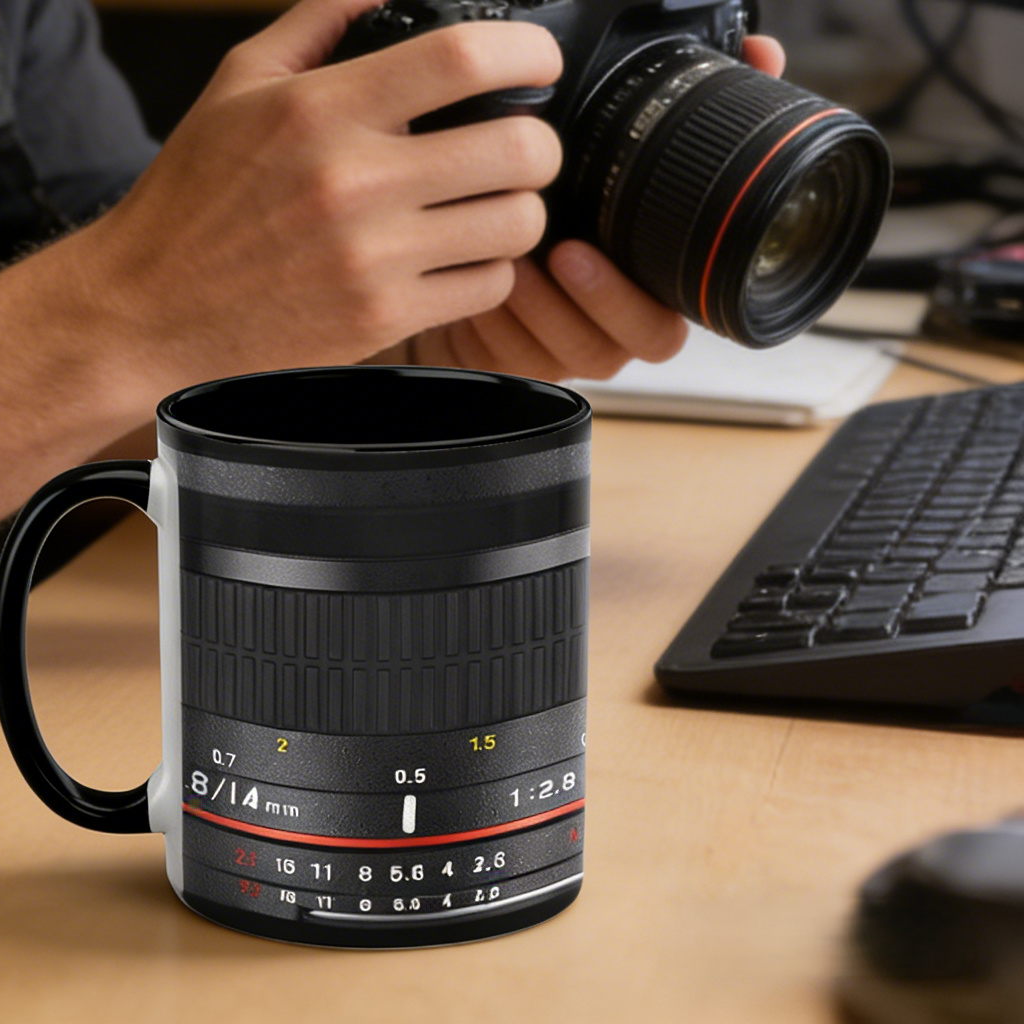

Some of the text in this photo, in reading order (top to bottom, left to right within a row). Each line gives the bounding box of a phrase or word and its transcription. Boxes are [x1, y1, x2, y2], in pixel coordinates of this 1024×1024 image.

[277, 734, 497, 753] 2 1.5
[212, 748, 426, 784] 0.7 0.5
[276, 858, 296, 875] 16
[358, 865, 373, 882] 8
[390, 864, 424, 882] 5.6
